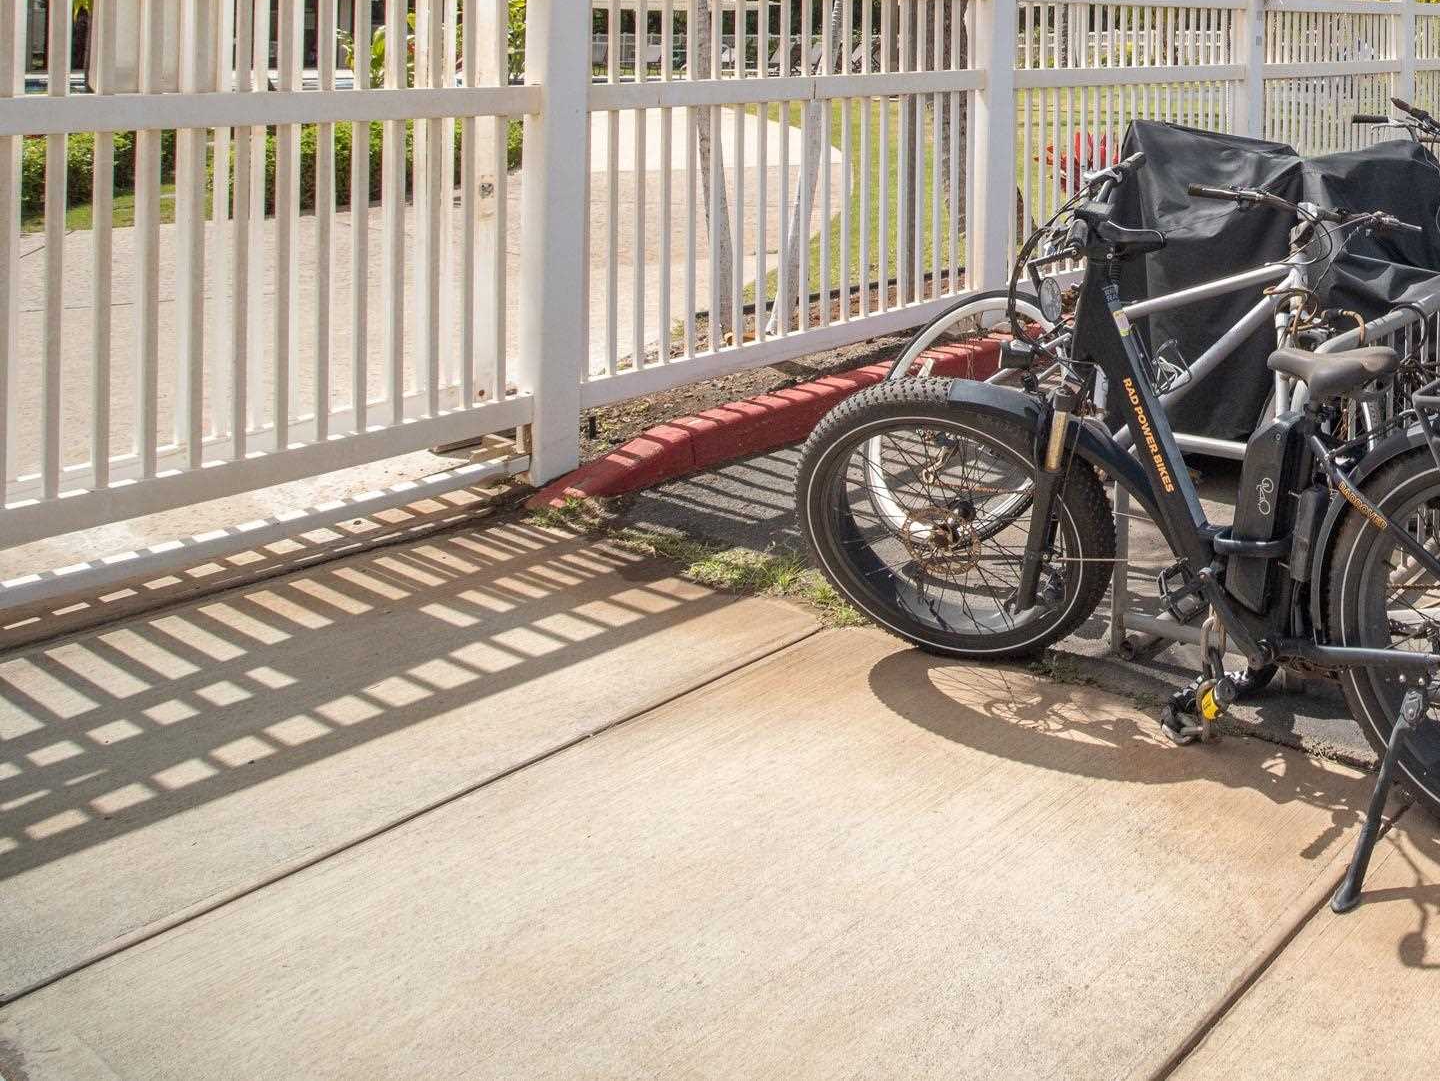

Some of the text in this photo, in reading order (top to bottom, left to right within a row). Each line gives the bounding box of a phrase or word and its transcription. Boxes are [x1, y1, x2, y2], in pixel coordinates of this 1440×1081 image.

[1123, 378, 1175, 493] RAD POWER BIKES
